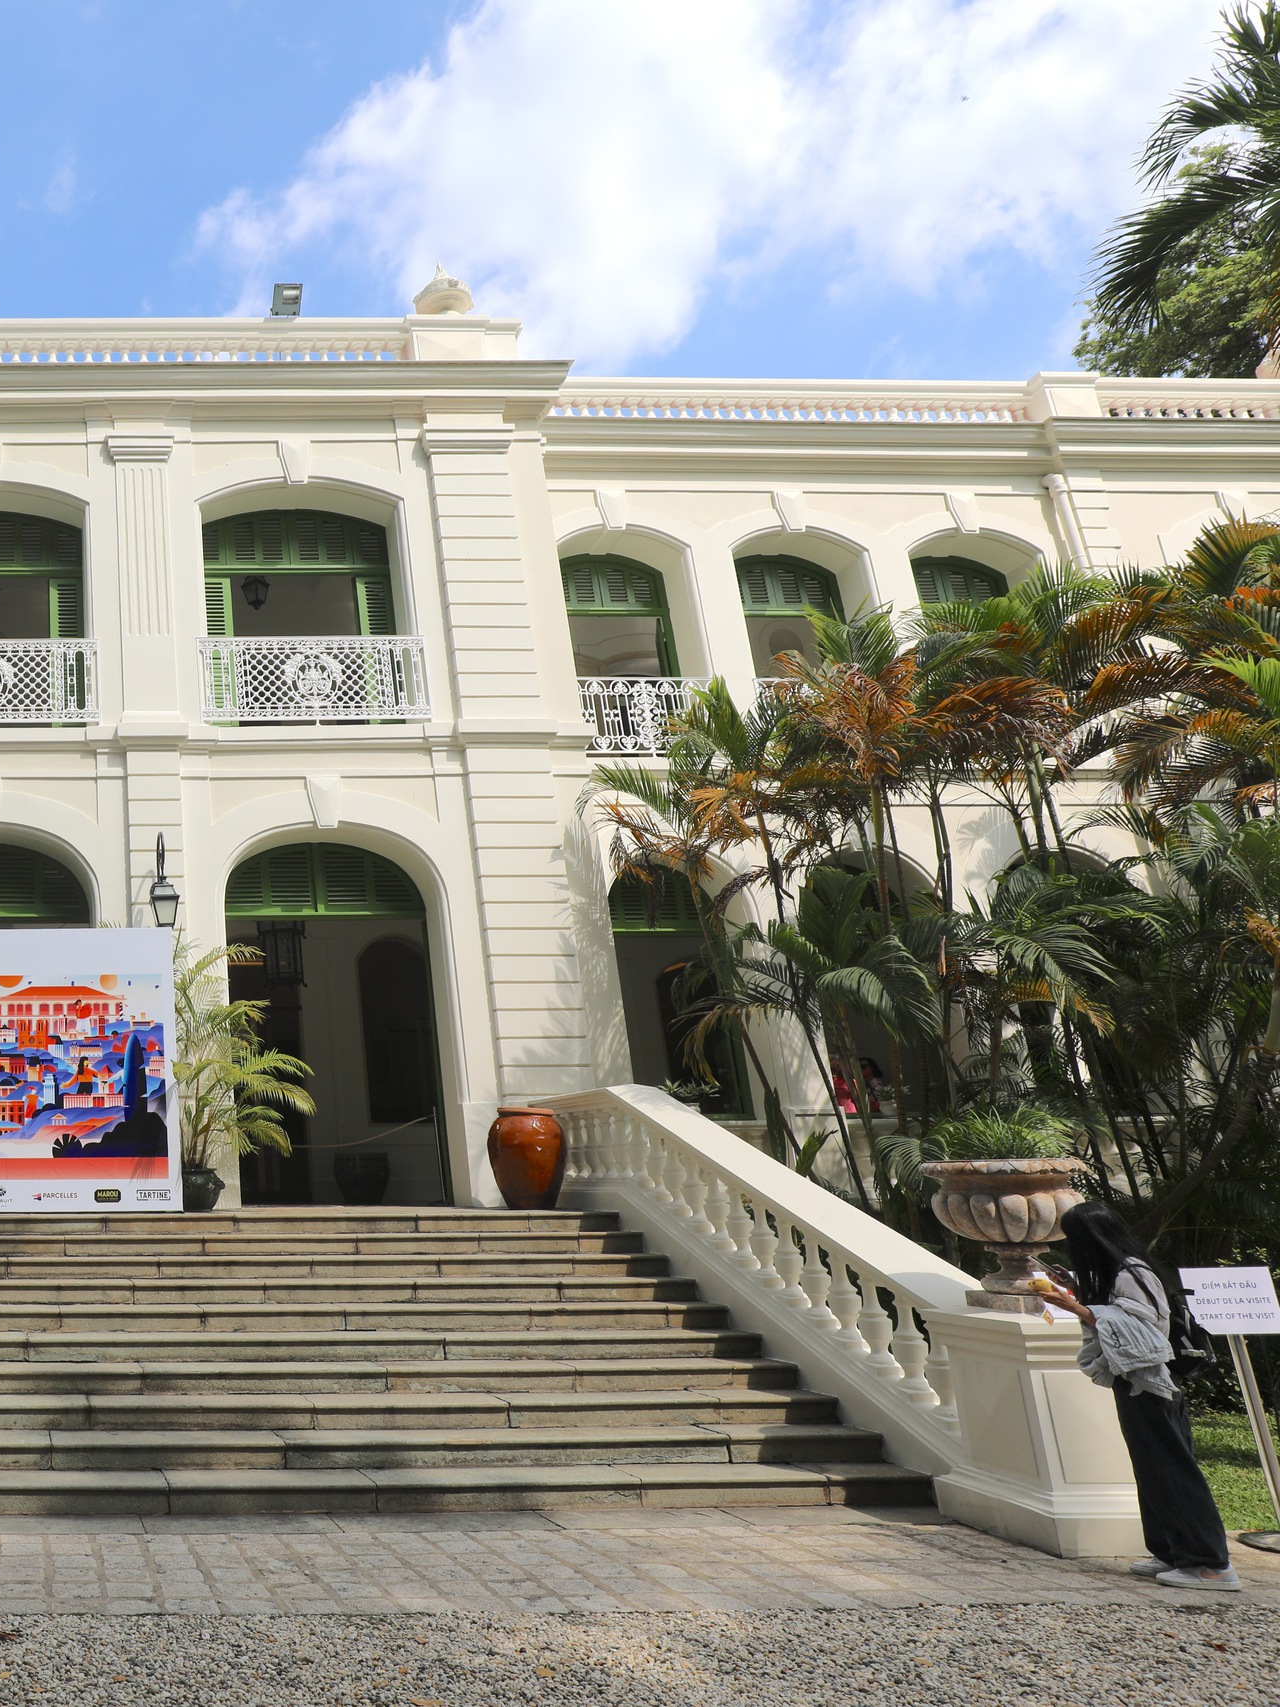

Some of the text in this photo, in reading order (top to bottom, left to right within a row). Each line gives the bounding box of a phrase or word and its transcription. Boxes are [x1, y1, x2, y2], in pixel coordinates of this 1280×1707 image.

[96, 1190, 119, 1198] MAROU
[139, 1191, 168, 1199] TARTINE
[1195, 1297, 1220, 1305] DÉBUT
